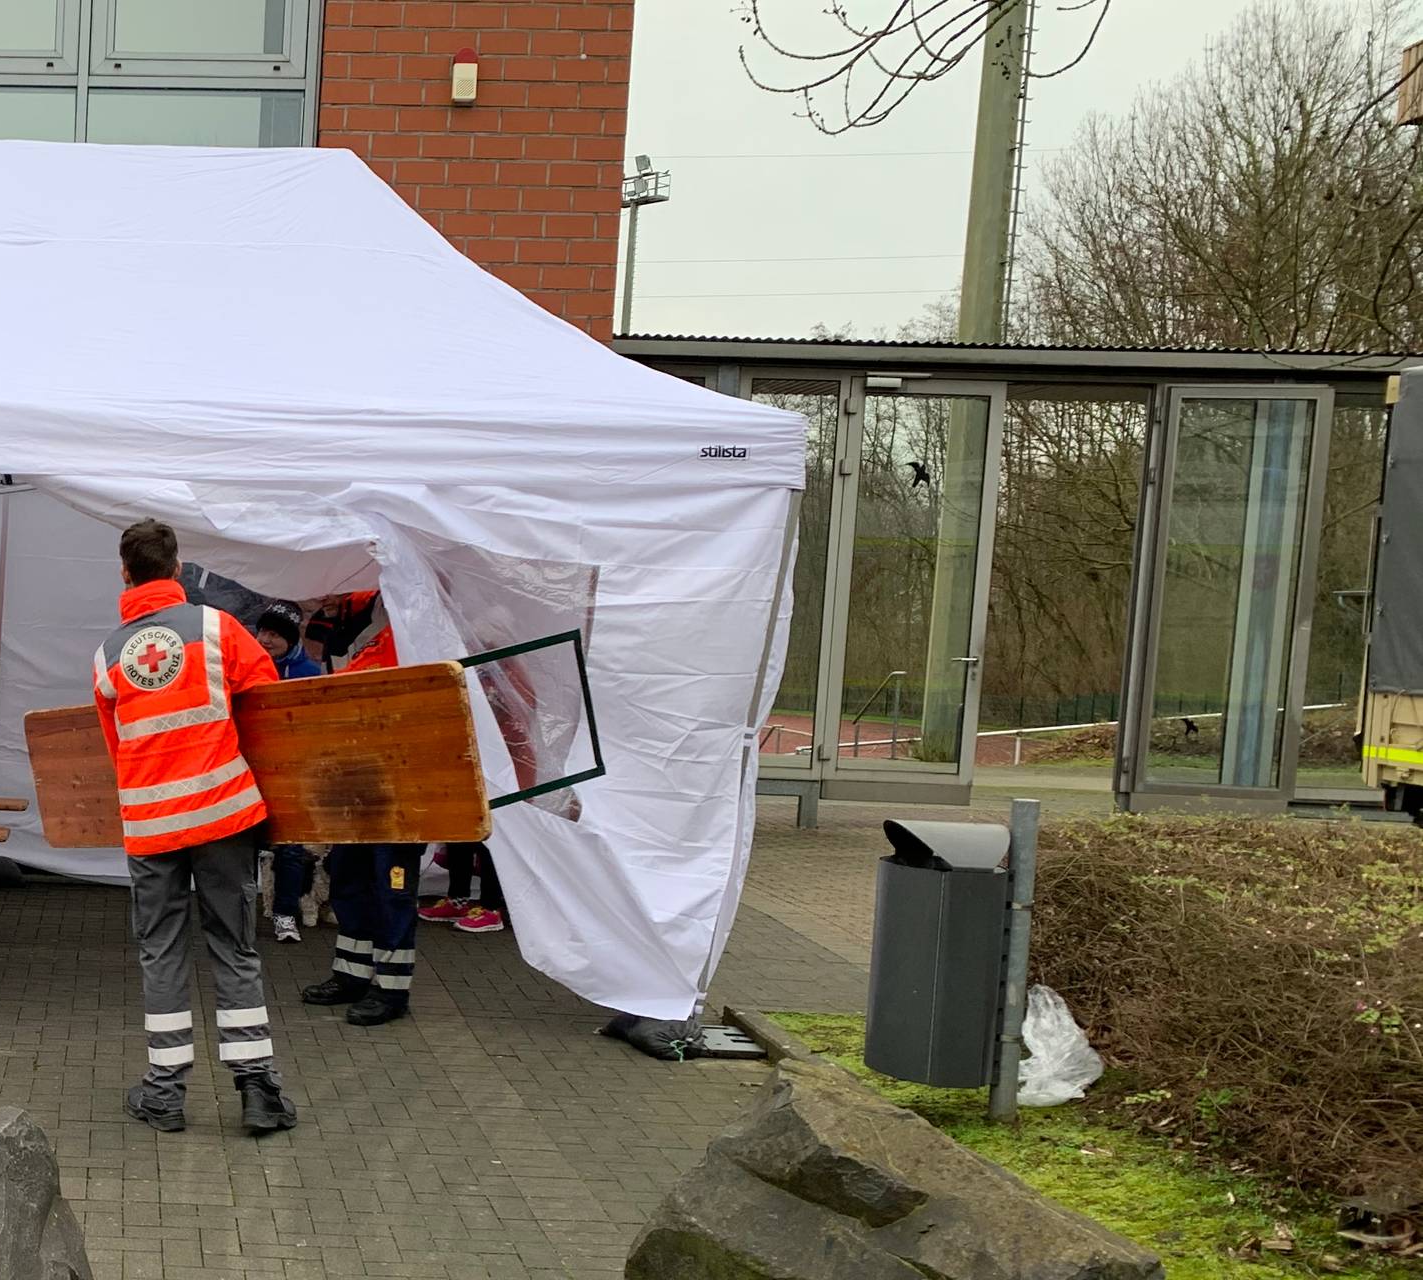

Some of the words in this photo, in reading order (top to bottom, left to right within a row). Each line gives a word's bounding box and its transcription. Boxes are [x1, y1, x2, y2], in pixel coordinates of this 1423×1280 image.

[700, 445, 747, 458] stilista
[127, 631, 177, 656] DEUTSCHES
[126, 664, 154, 687] ROTES
[158, 654, 180, 684] KREUZ
